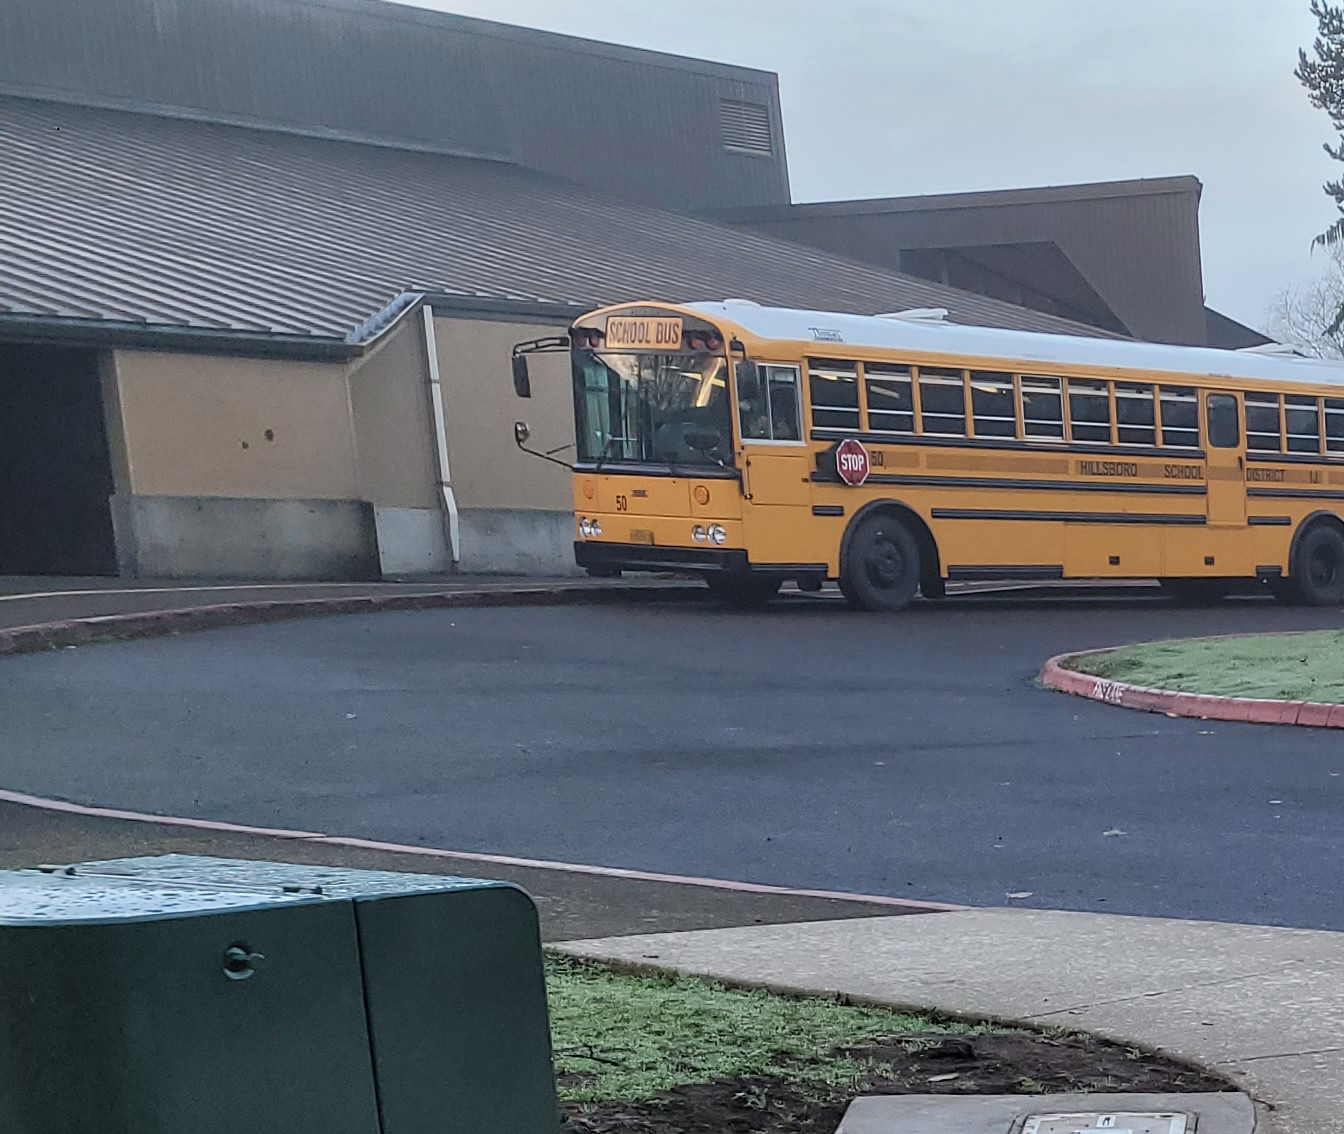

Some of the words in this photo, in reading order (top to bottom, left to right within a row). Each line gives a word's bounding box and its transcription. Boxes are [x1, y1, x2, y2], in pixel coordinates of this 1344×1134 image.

[609, 321, 651, 344] SCHOOL
[655, 323, 680, 345] BUS
[840, 453, 865, 472] STOP
[871, 451, 884, 467] 50
[1080, 460, 1138, 478] HILLSBORO
[1164, 464, 1205, 480] SCHOOL
[1246, 468, 1285, 482] DISTRICT
[615, 494, 628, 512] 50
